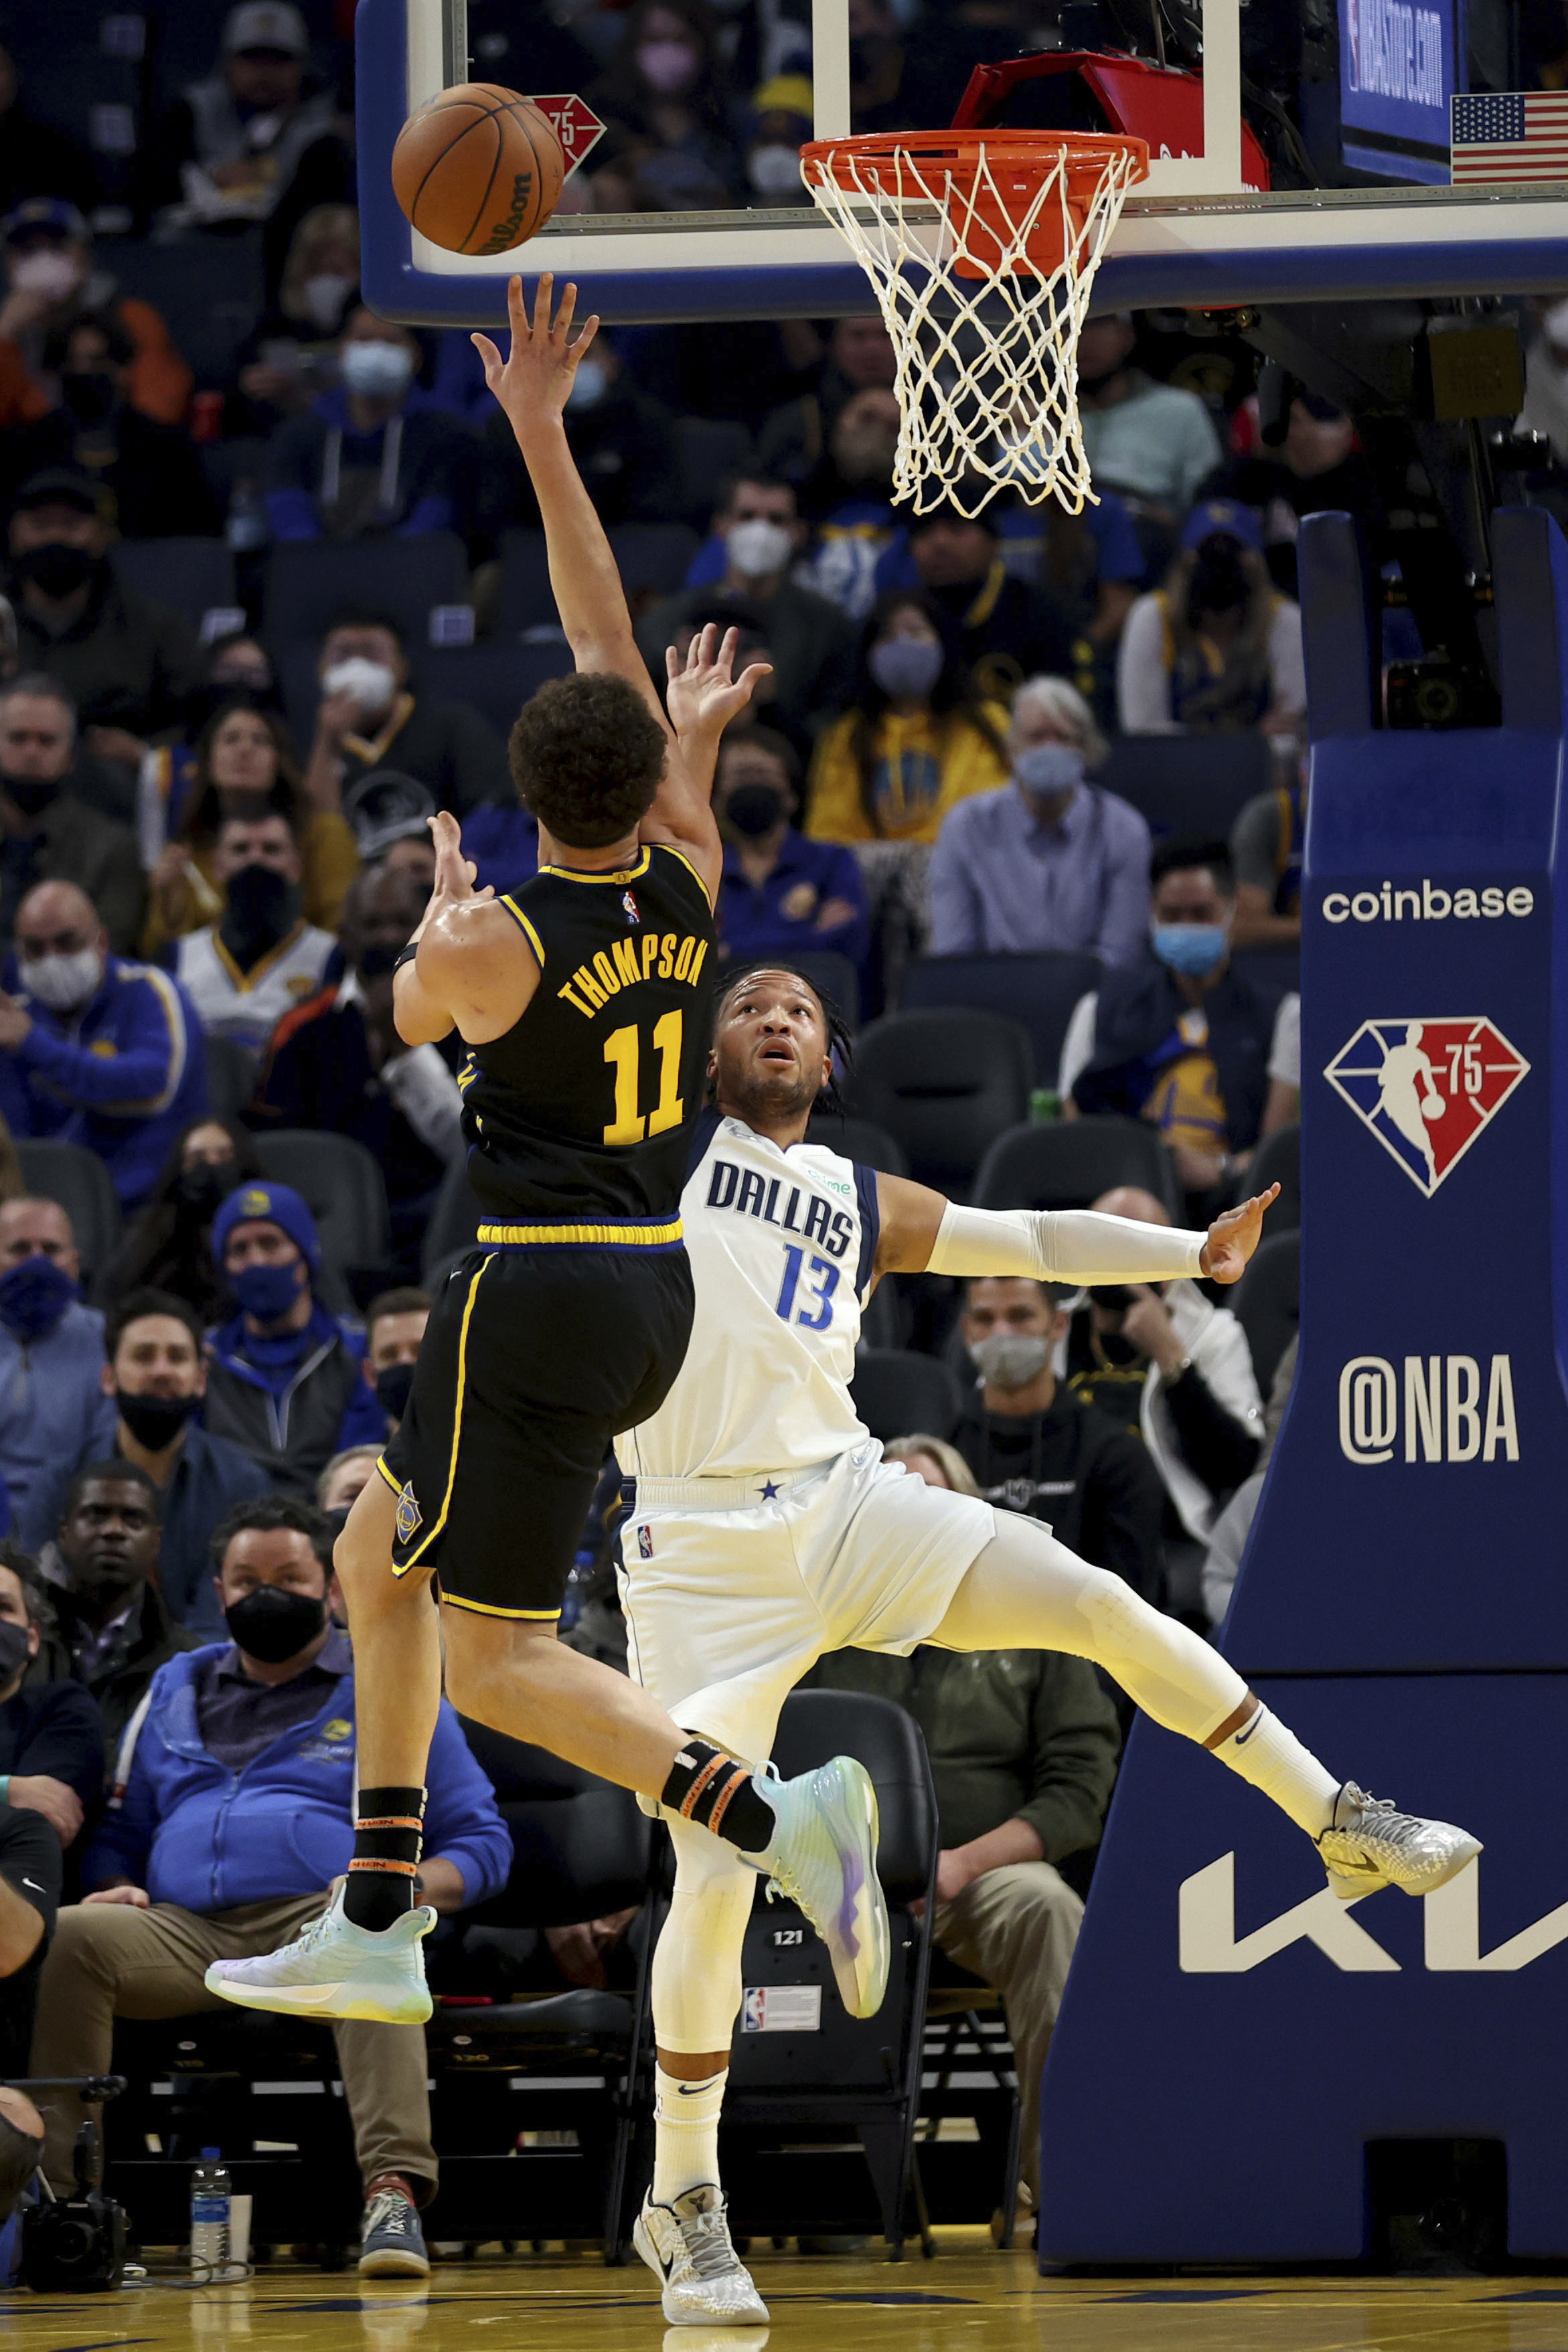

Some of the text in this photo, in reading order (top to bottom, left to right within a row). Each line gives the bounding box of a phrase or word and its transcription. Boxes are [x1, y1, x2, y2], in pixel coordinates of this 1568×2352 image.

[1322, 879, 1534, 923] coinbase
[557, 933, 708, 1019] THOMPSON
[603, 1008, 684, 1146] 11
[1445, 1044, 1482, 1095] 75
[704, 1160, 854, 1259] DALLAS
[775, 1242, 841, 1332] 13
[1340, 1354, 1520, 1464] @NBA
[773, 1930, 803, 1946] 121
